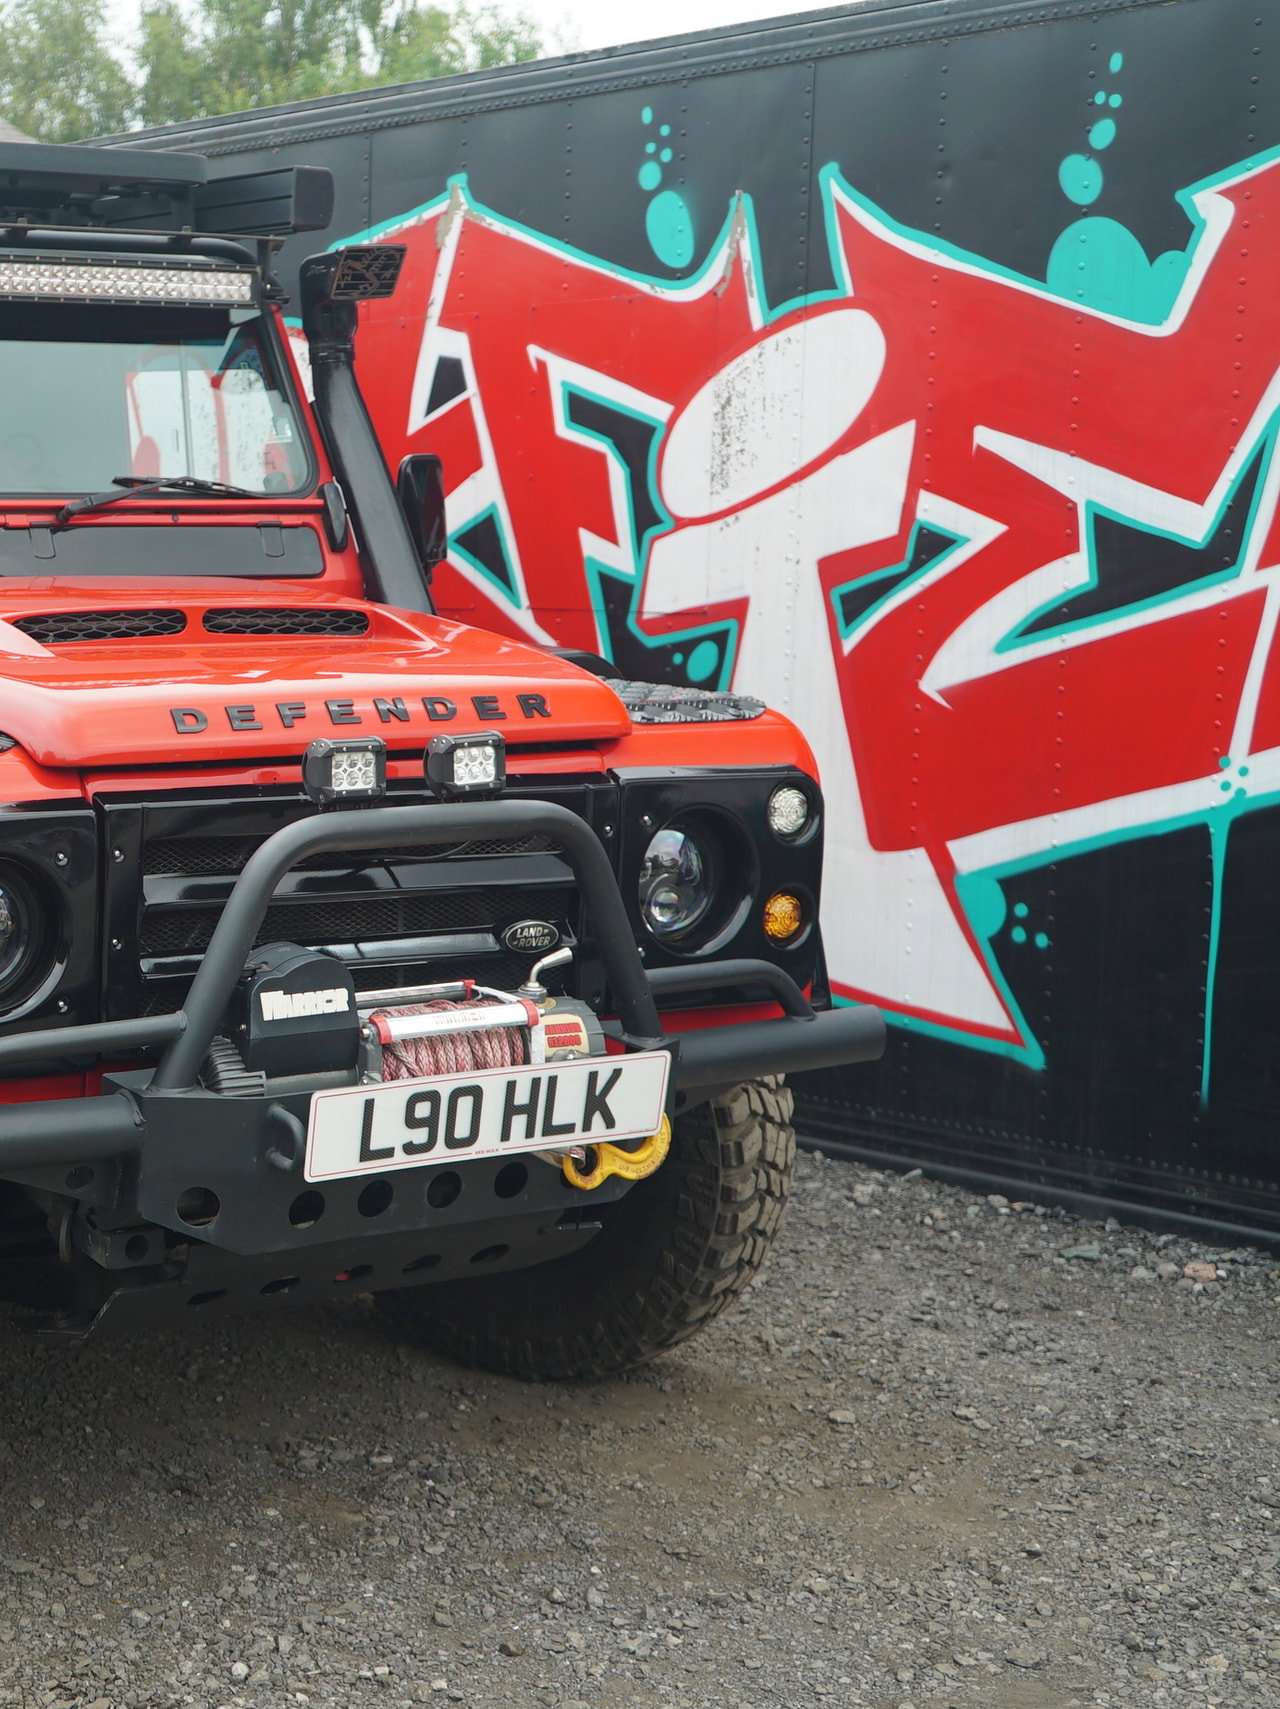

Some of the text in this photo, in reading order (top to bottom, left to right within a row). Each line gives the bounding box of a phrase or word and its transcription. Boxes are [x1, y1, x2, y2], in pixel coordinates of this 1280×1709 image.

[169, 693, 552, 735] DEFENDER
[516, 926, 542, 937] LAND
[519, 936, 550, 947] ROVER
[358, 1066, 623, 1163] L90 HLK
